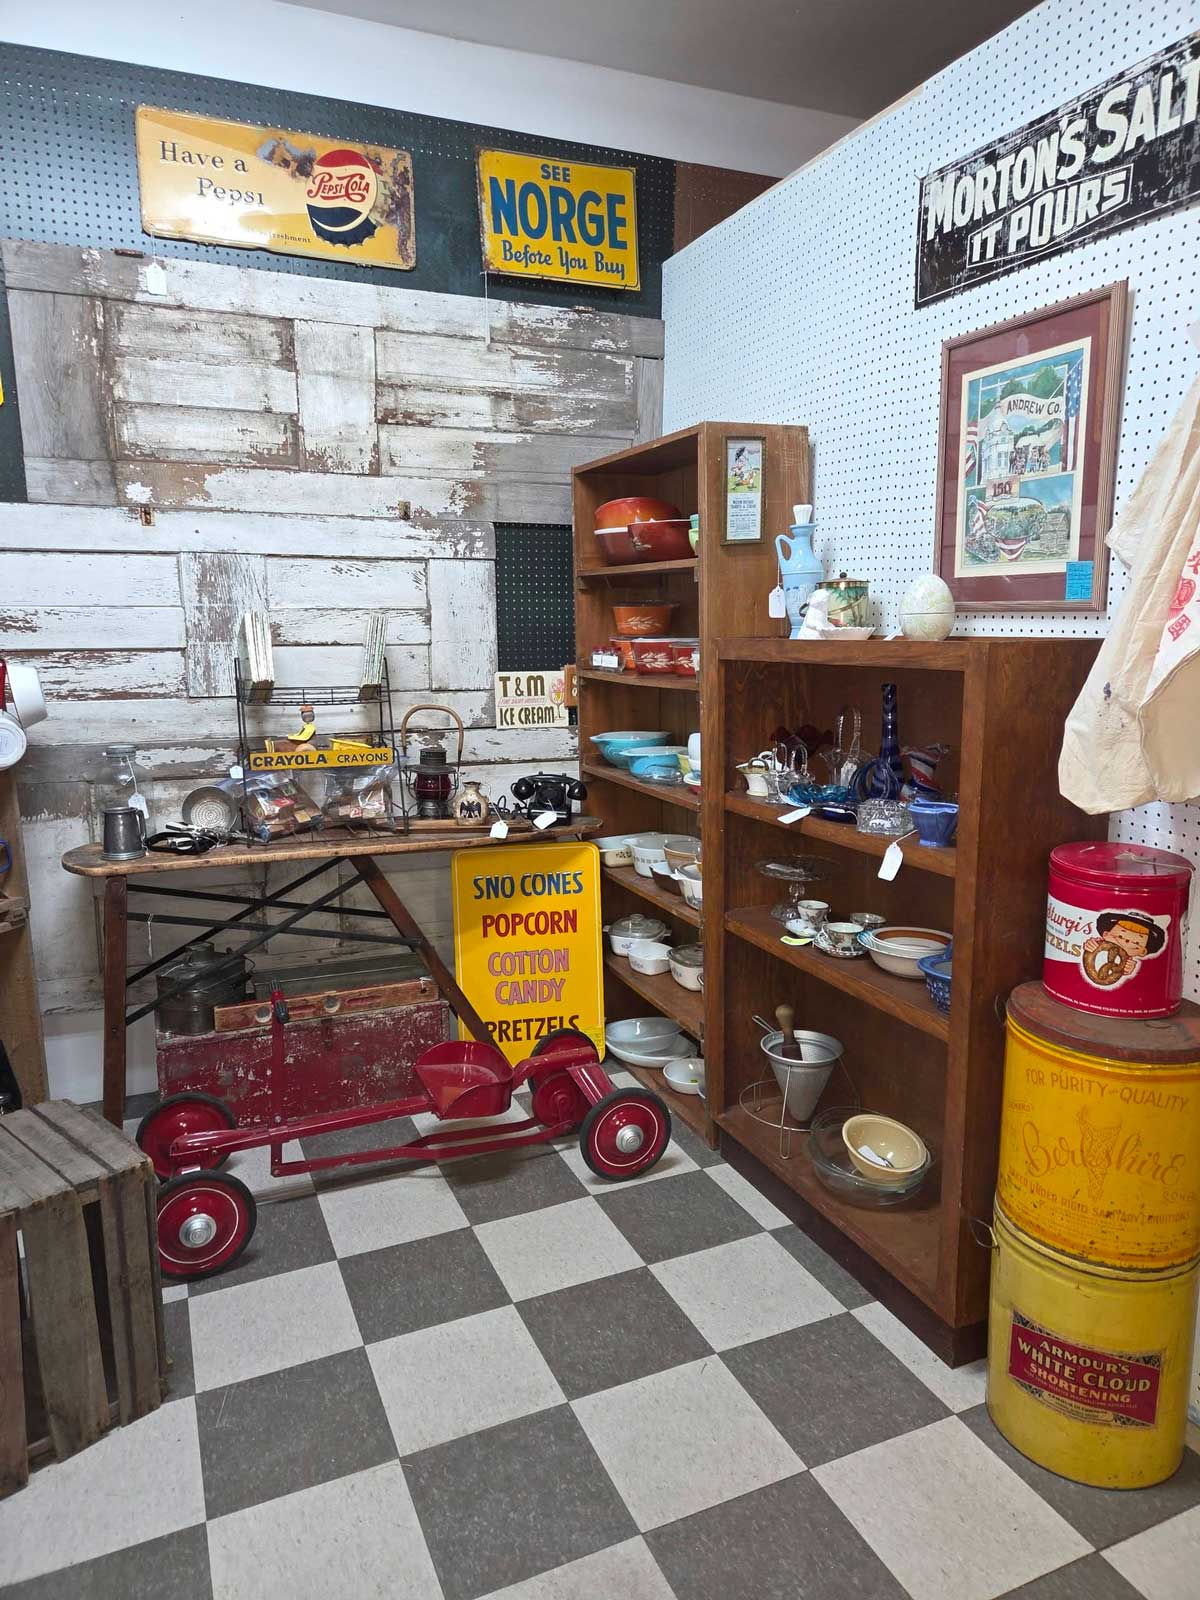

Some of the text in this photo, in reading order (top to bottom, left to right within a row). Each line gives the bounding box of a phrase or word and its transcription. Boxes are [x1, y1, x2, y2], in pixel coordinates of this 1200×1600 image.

[160, 141, 249, 173] Have a
[926, 58, 1200, 241] MORTON'S SALT
[541, 164, 571, 183] SEE
[197, 176, 265, 206] Pepsi
[489, 176, 628, 250] NORGE
[971, 170, 1127, 263] IT POURS
[501, 240, 625, 280] Before You Buy
[1006, 399, 1044, 415] ANDREW
[499, 675, 545, 698] T & M
[500, 706, 555, 726] ICE CREAM
[253, 753, 389, 767] CRAYOLA CRAYONS
[473, 871, 584, 900] SNO CONES
[482, 909, 578, 938] POPCORN
[488, 948, 570, 977] COTTON
[495, 978, 566, 1006] CANDY
[1026, 1069, 1190, 1112] FOR PURITY QUALITY
[1017, 1336, 1077, 1380] WHITE
[1083, 1372, 1151, 1393] CLOUD
[1040, 1340, 1130, 1375] ARMOUR'S
[1029, 1363, 1131, 1403] SHORTENING
